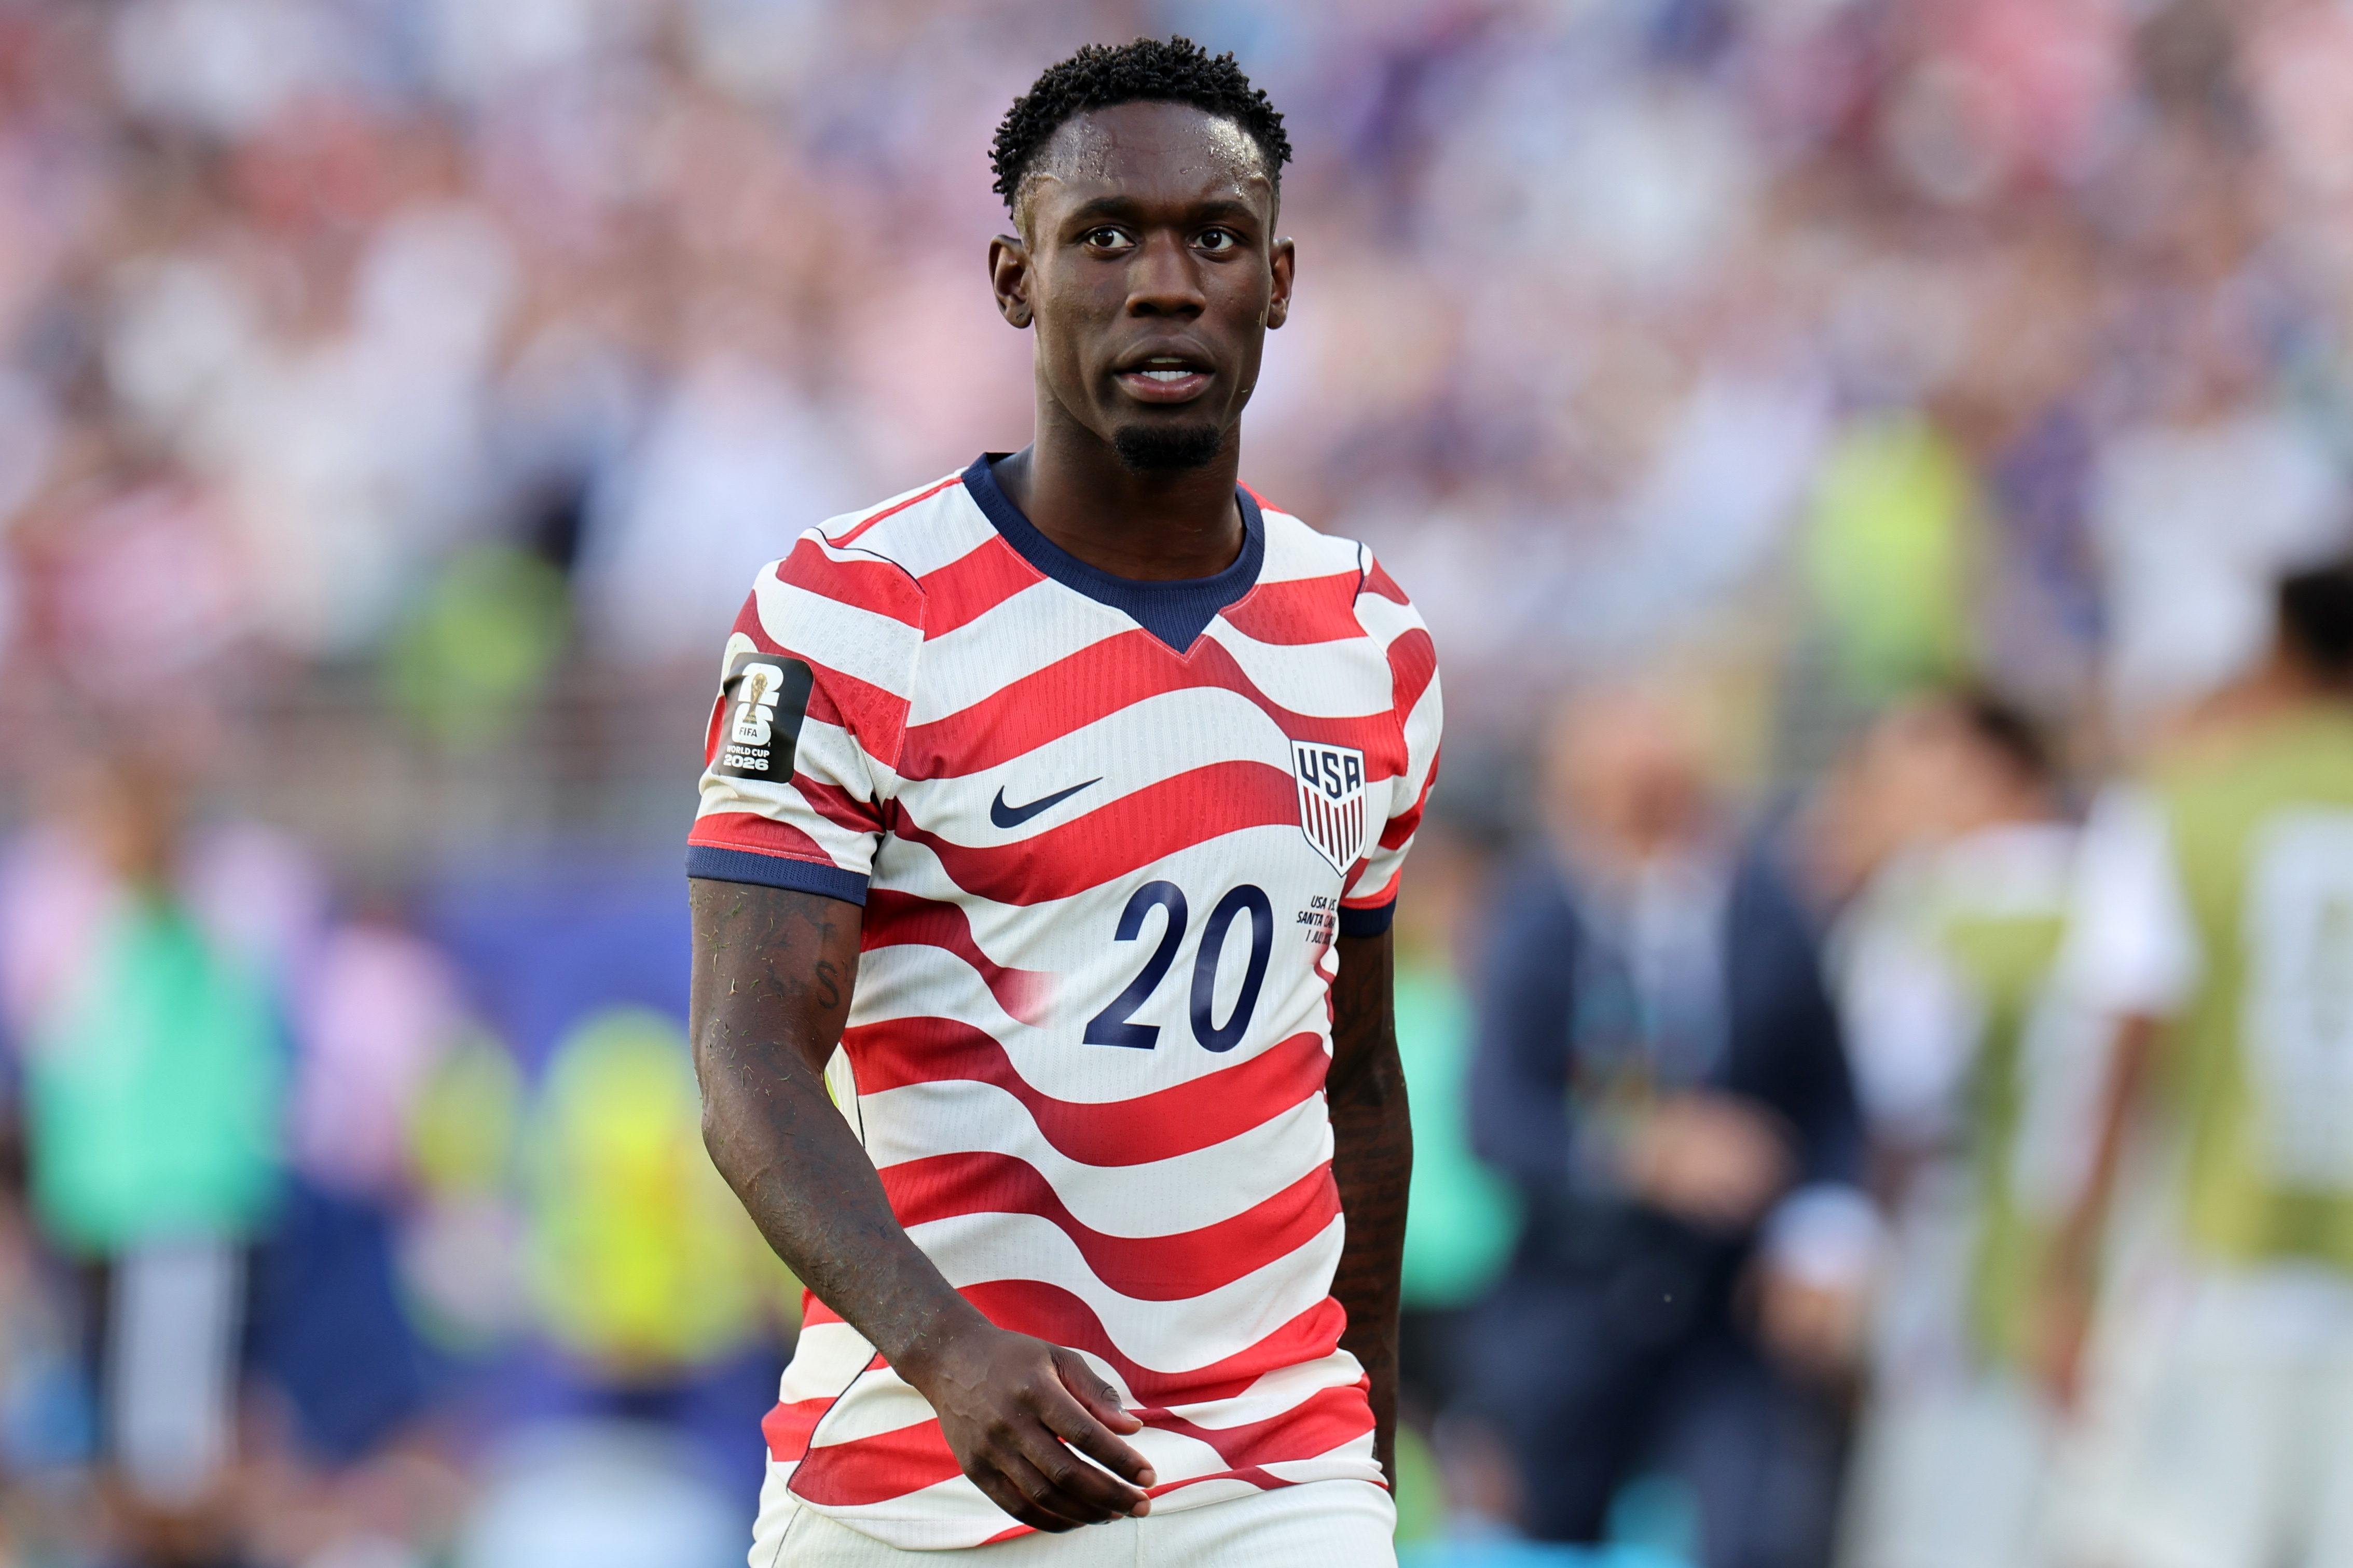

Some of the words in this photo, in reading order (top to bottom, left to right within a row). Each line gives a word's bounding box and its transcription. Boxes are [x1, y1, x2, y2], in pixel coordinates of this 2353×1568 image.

[738, 727, 758, 738] FIFA
[726, 744, 751, 755] WORLD
[751, 747, 770, 758] CUP
[723, 754, 769, 771] 2026
[1298, 748, 1361, 799] USA
[1311, 895, 1328, 909] USA
[1296, 911, 1324, 926] SANTA
[1082, 880, 1274, 1052] 20
